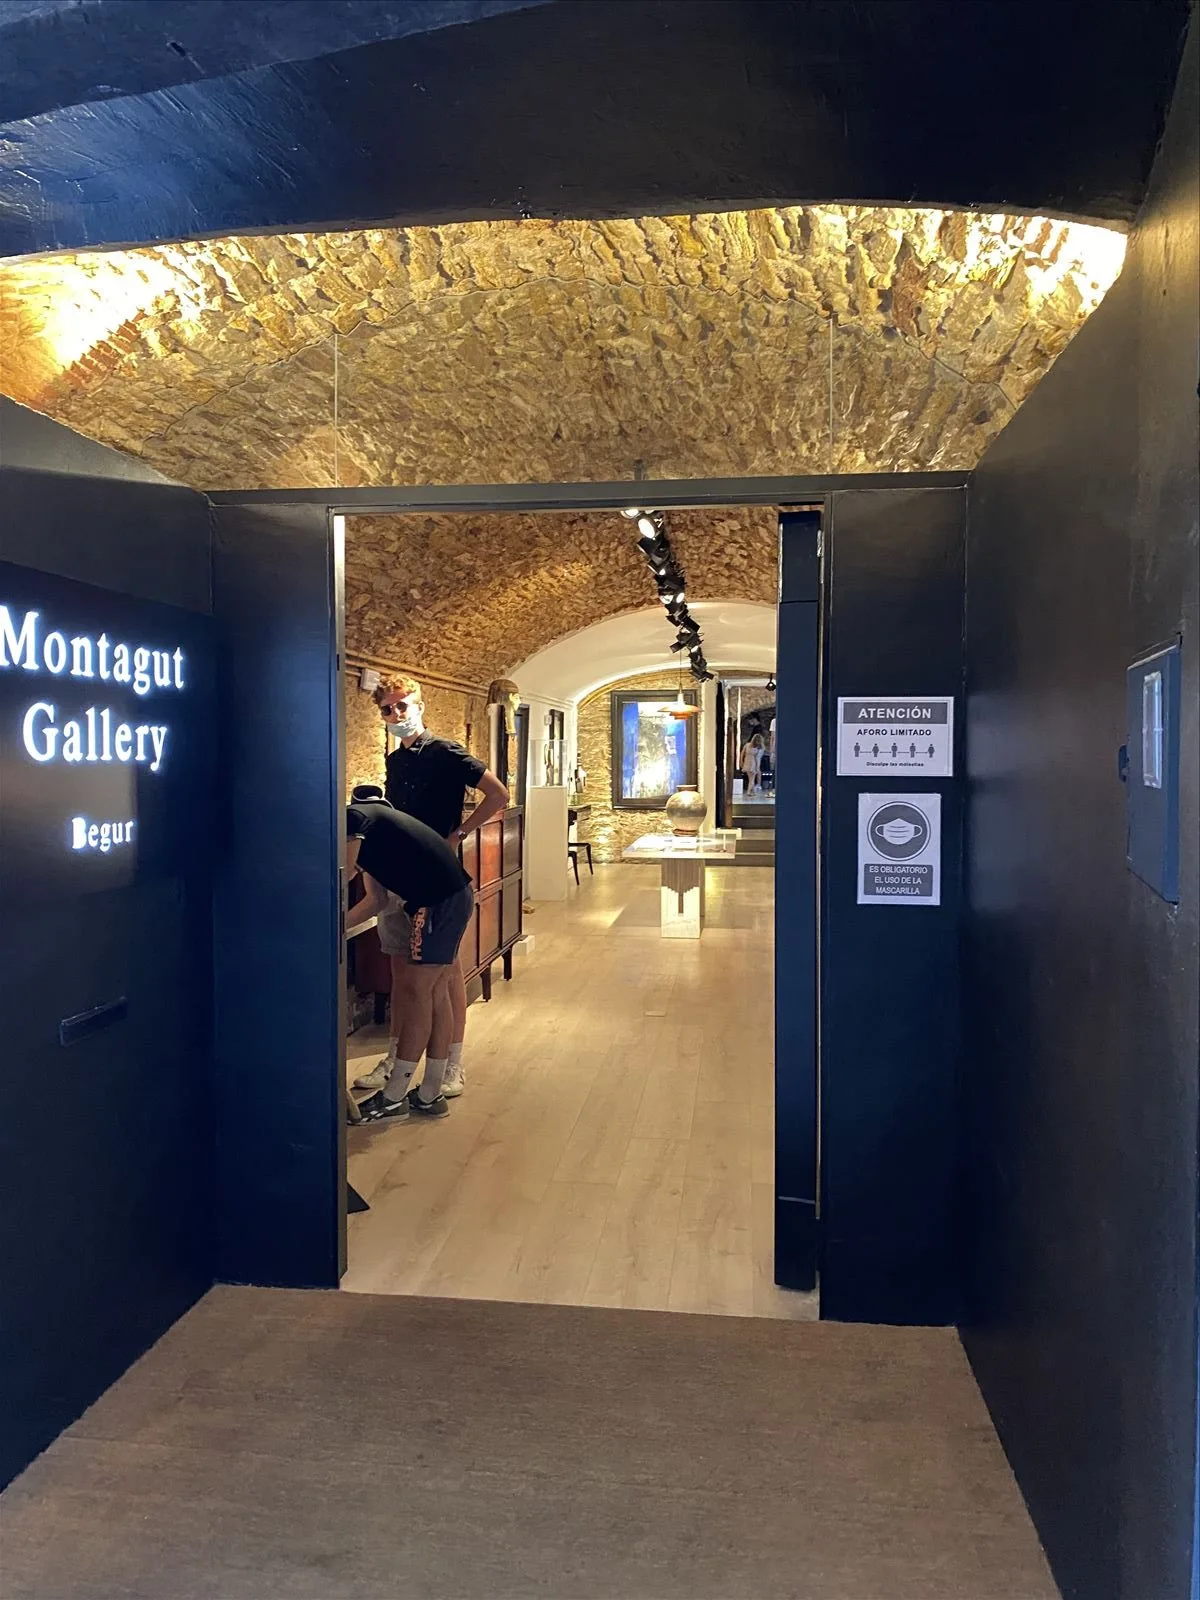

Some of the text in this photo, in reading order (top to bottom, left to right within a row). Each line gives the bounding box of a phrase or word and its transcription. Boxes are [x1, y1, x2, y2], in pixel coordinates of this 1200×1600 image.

[0, 605, 185, 695] Montagut
[858, 705, 932, 719] ATENCIÓN
[22, 702, 168, 772] Gallery
[857, 728, 932, 736] AFORO LIMITADO
[72, 817, 134, 852] Begur
[869, 865, 928, 874] ES OBLIGATORIO
[874, 876, 884, 884] EL
[884, 876, 900, 884] USO
[901, 876, 911, 884] DE
[875, 886, 920, 895] MASCARILLA
